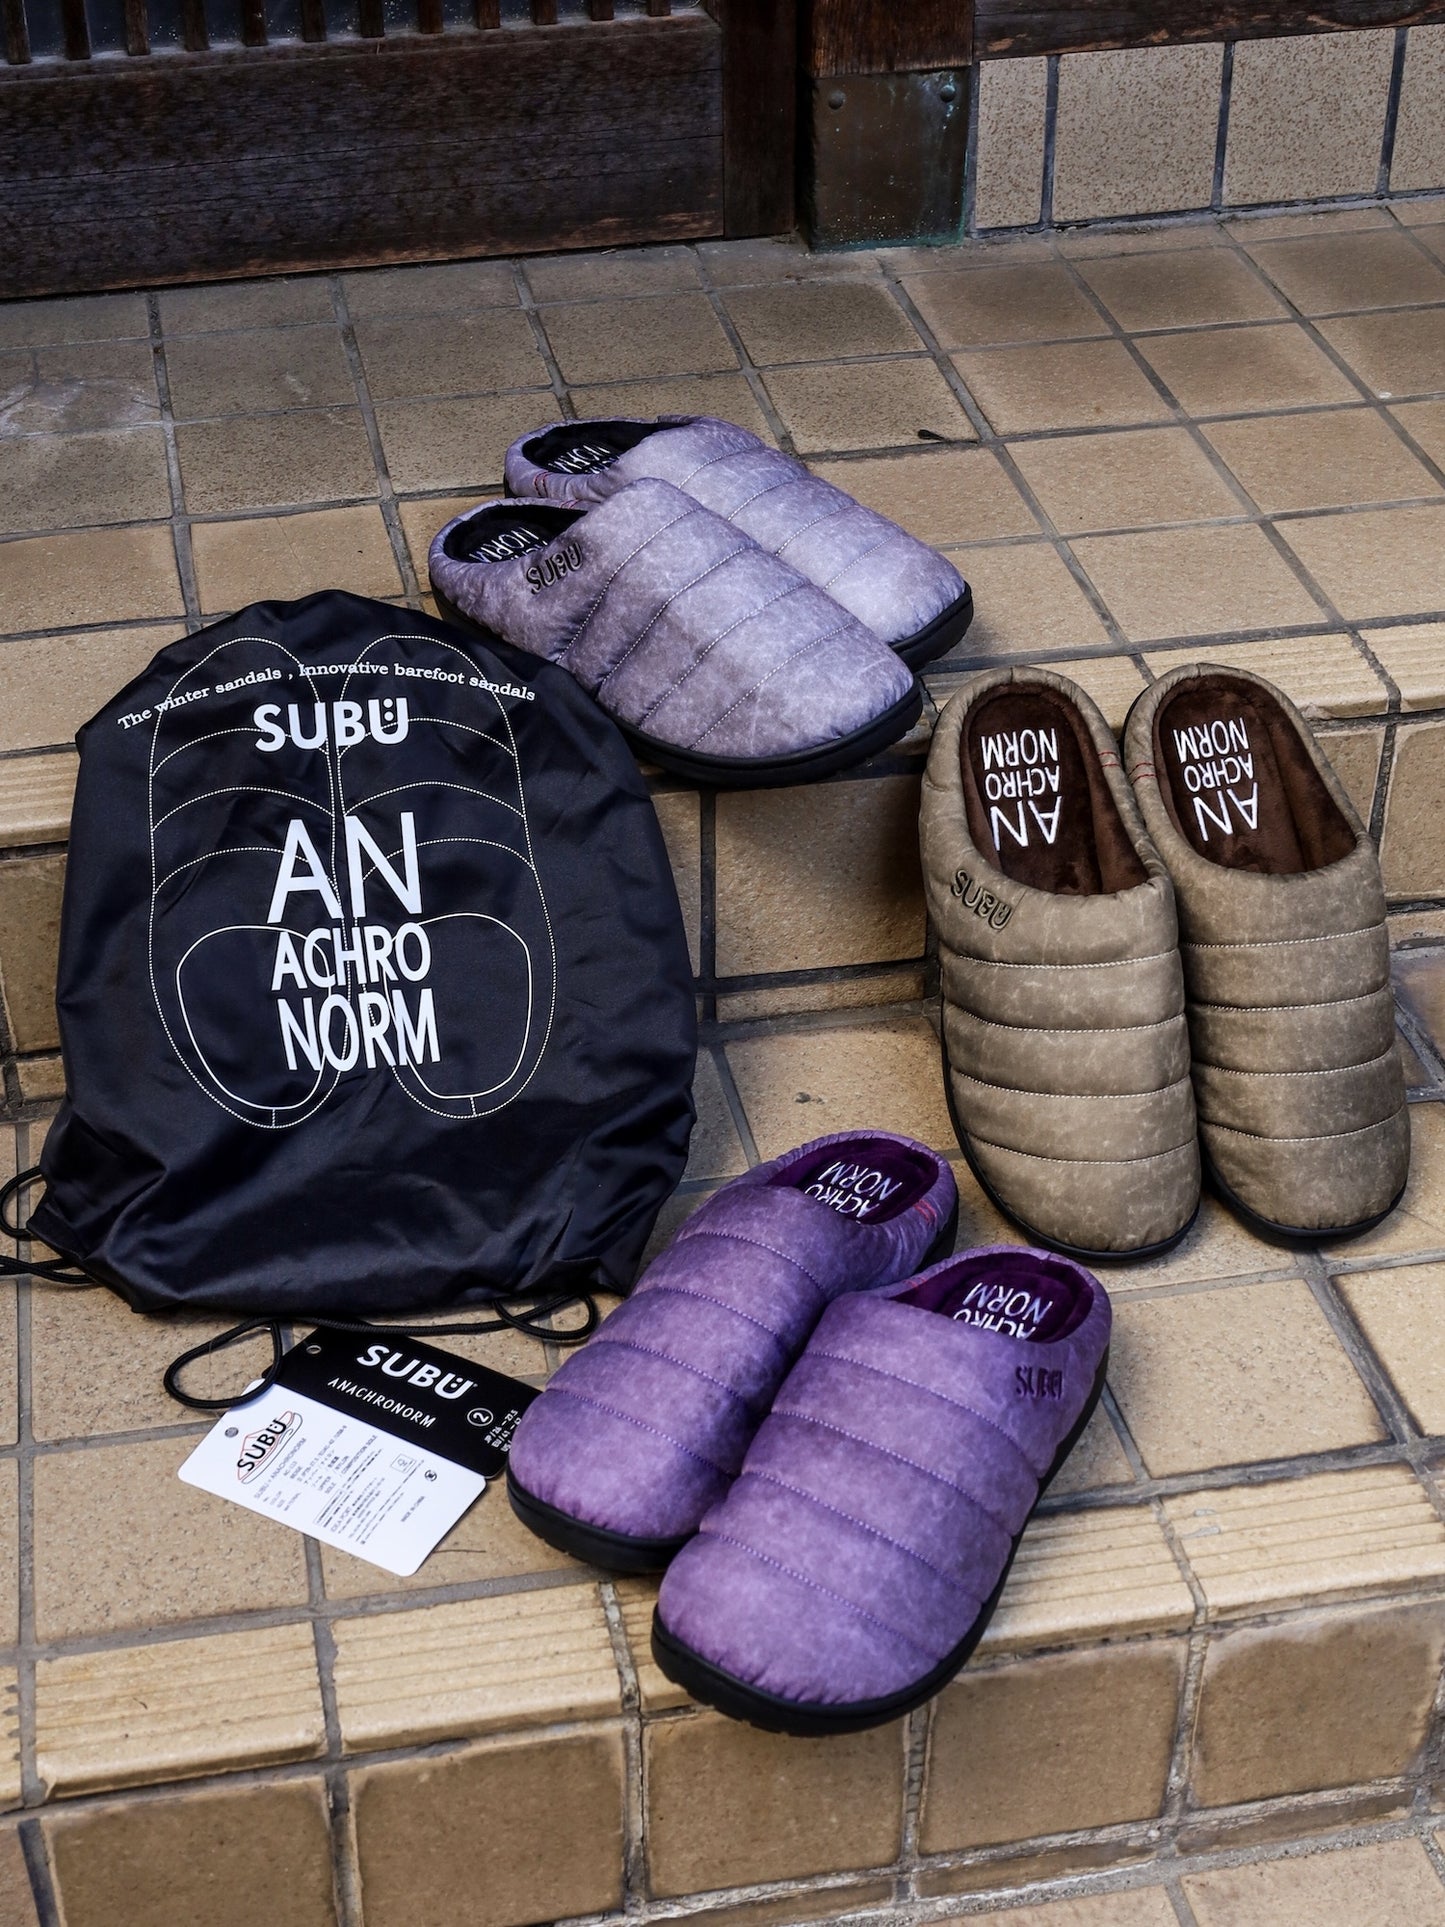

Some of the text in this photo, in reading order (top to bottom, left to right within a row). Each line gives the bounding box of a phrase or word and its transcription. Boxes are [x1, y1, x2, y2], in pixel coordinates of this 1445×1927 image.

[117, 708, 152, 731] The
[155, 686, 210, 713] winter
[299, 663, 389, 677] Innovative
[394, 663, 466, 685] barefoot
[469, 675, 537, 702] sandals
[981, 728, 1058, 770] NORM
[1173, 717, 1250, 763] NORM
[985, 766, 1060, 800] ACHRO
[1183, 753, 1255, 793] ACHRO
[989, 795, 1062, 851] AN
[1192, 782, 1258, 842] AN
[267, 811, 422, 923] AN
[271, 922, 431, 990] ACHRO
[277, 988, 441, 1071] NORM
[817, 1160, 902, 1201] NORM
[962, 1282, 1053, 1323] NORM
[327, 1377, 438, 1429] ANACHRONORM
